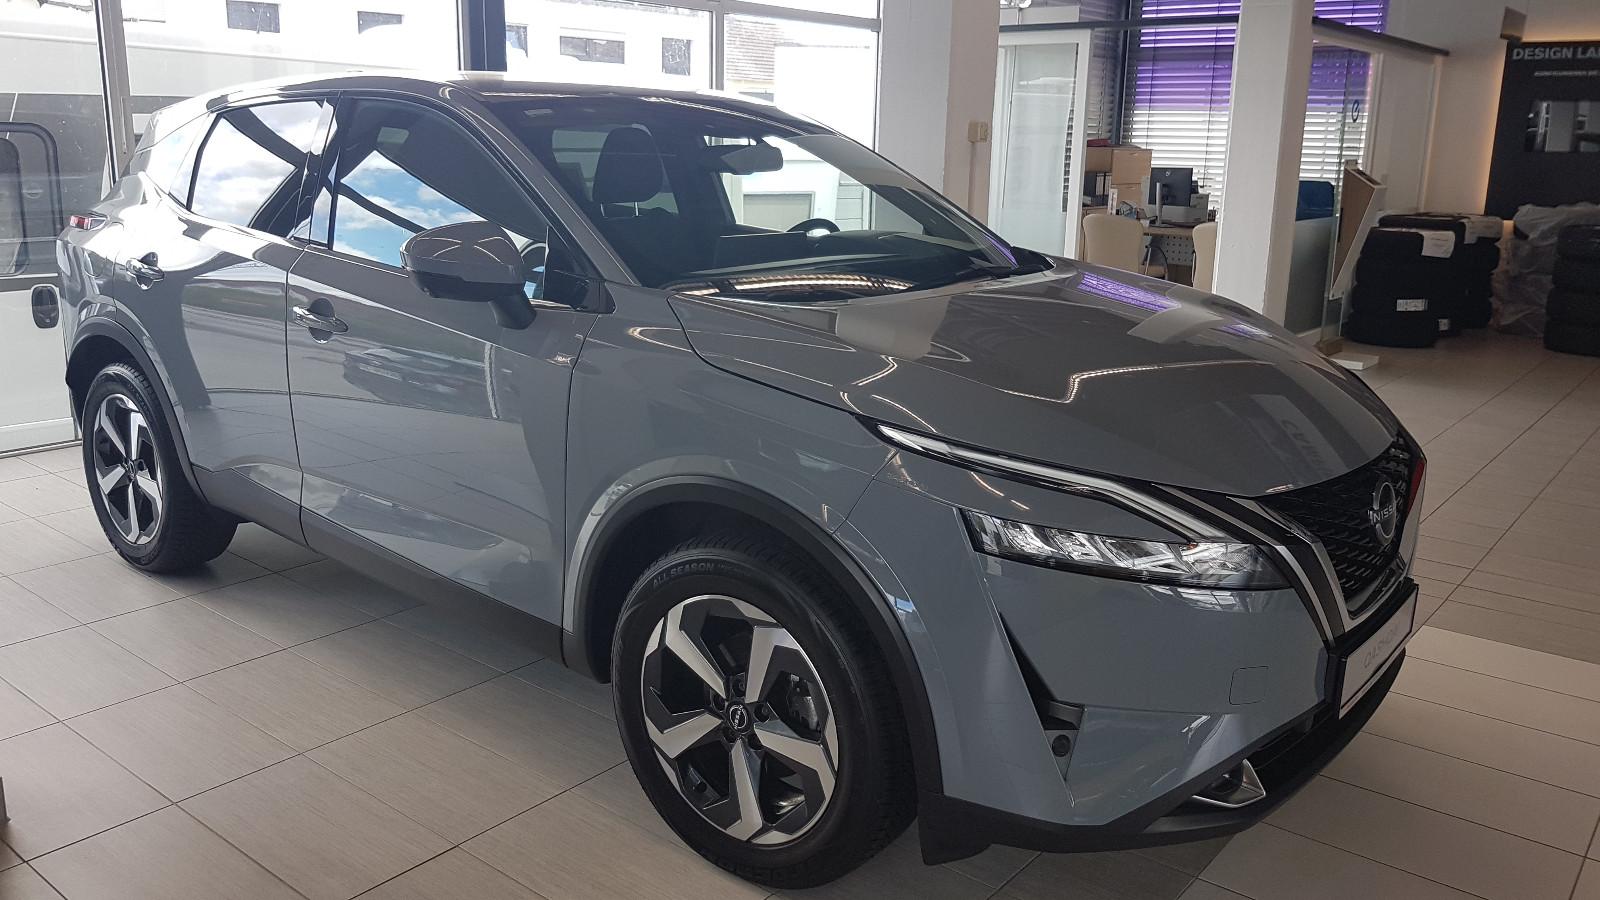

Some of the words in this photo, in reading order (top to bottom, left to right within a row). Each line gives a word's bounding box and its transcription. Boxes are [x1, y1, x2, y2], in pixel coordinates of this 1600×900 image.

[1512, 47, 1574, 60] DESIGN
[652, 572, 668, 588] ALL
[670, 562, 715, 577] SEASON
